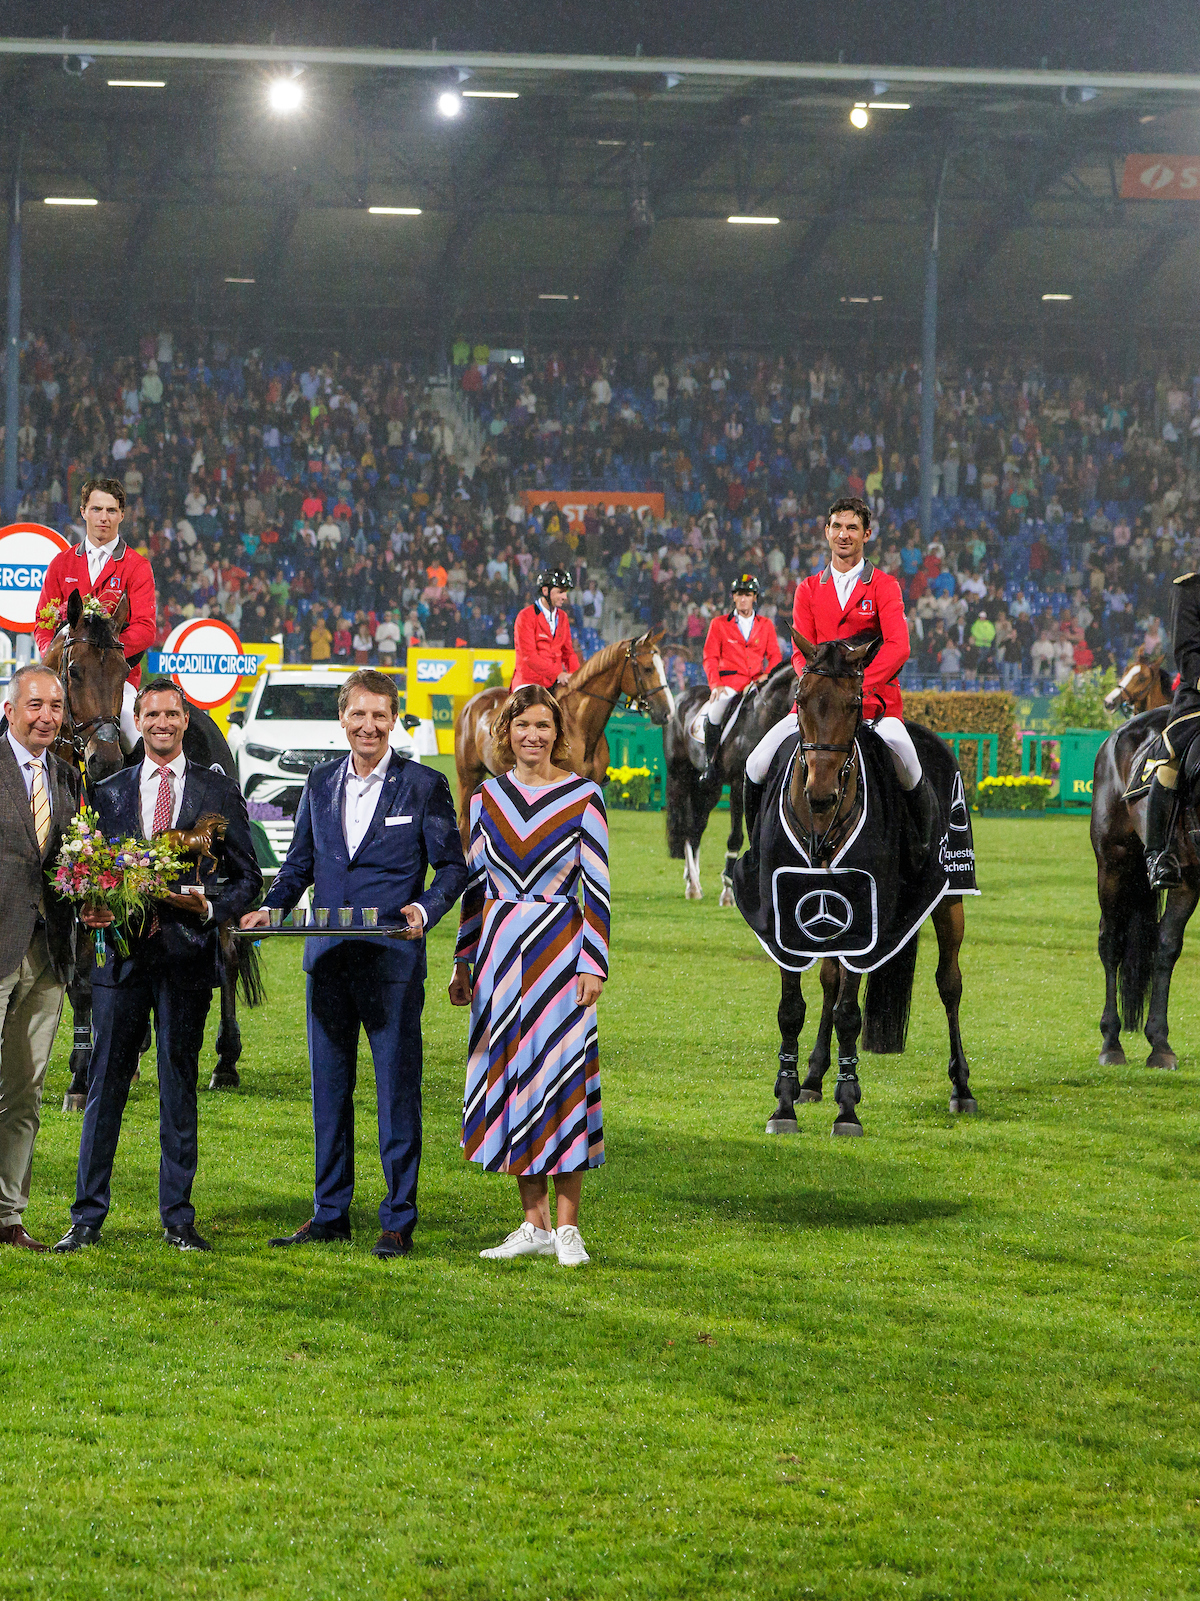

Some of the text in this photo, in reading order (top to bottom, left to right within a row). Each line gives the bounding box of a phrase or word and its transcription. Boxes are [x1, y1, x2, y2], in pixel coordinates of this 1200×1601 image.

[159, 654, 257, 675] PICCADILLY CIRCUS
[417, 662, 448, 680] SAP
